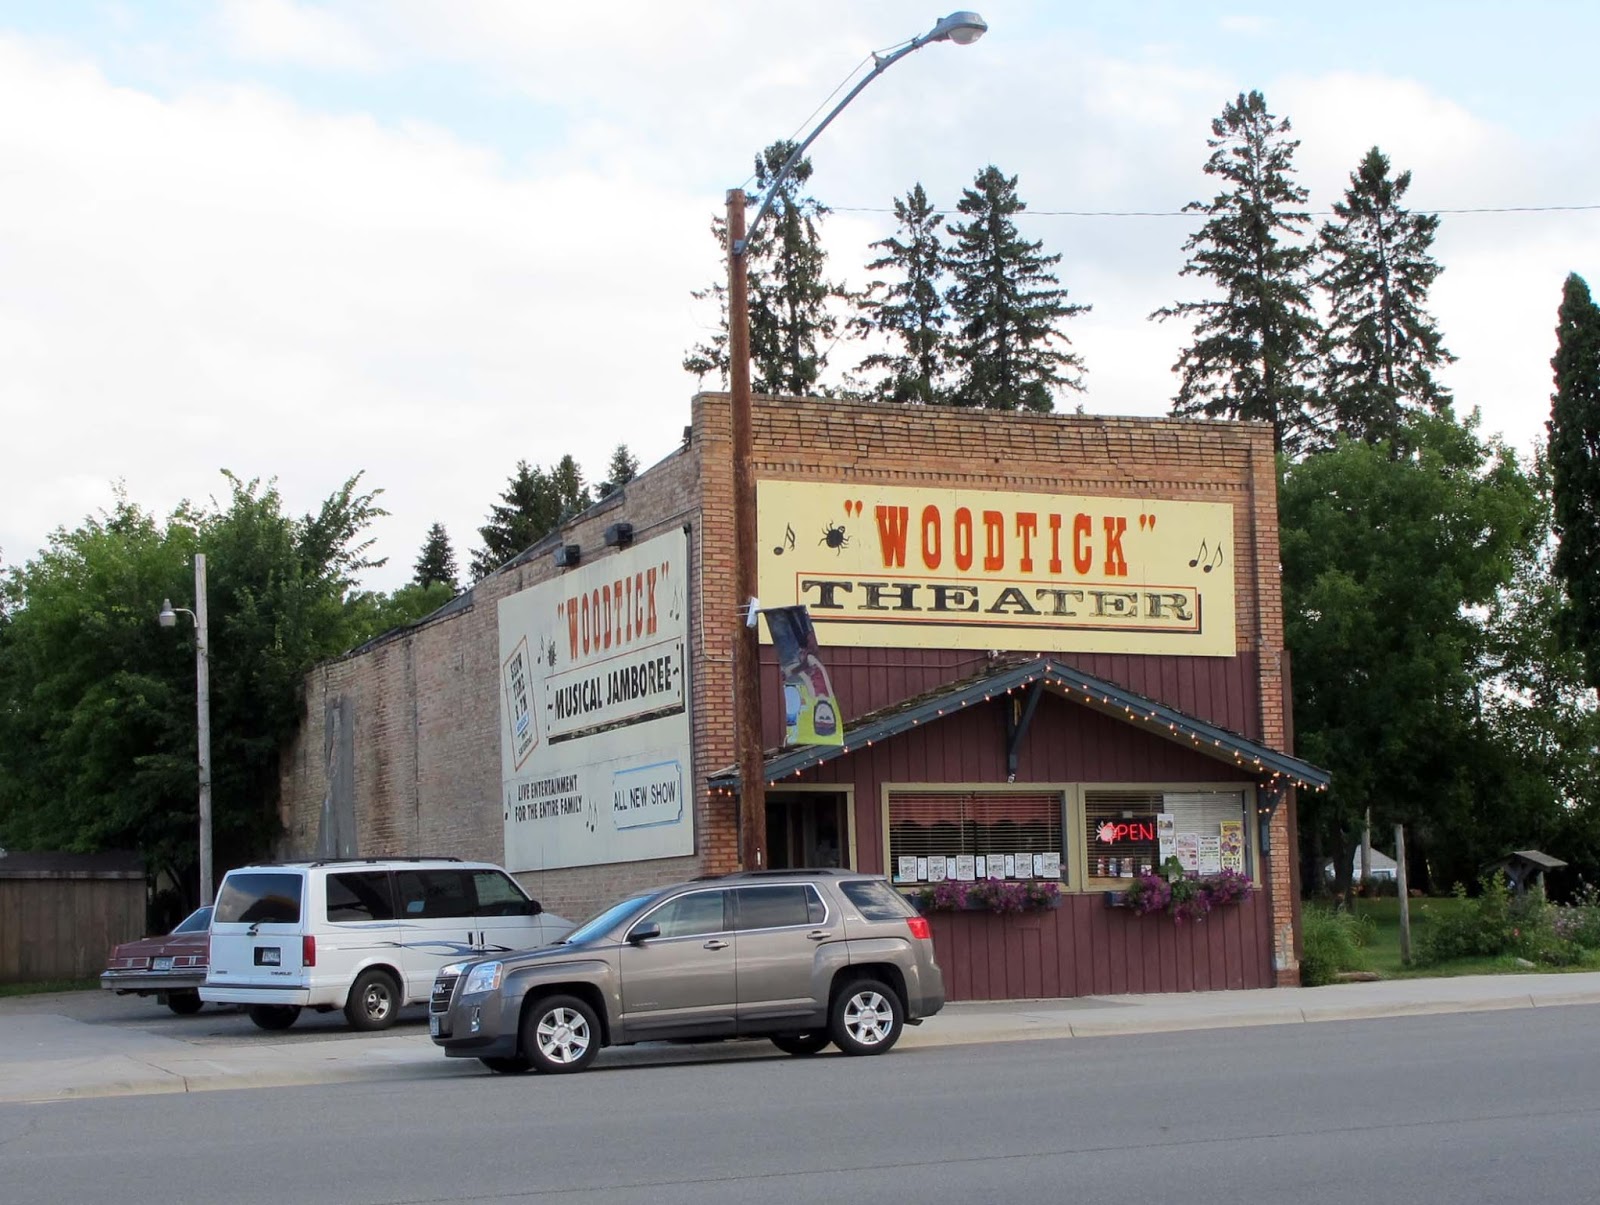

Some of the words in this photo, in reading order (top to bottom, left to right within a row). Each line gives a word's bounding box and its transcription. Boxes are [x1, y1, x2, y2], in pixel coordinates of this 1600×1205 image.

[801, 580, 1194, 621] THEATER
[555, 676, 602, 720] MUSICAL
[607, 655, 671, 705] JAMBOREE
[518, 783, 530, 802] LIVE
[531, 774, 578, 799] ENTERTAINMENT
[613, 789, 628, 811] ALL
[630, 785, 647, 809] NEW
[651, 780, 676, 805] SHOW
[515, 805, 527, 823] FOR
[527, 803, 538, 820] THE
[539, 799, 559, 818] ENTIRE
[560, 795, 582, 815] FAMILY
